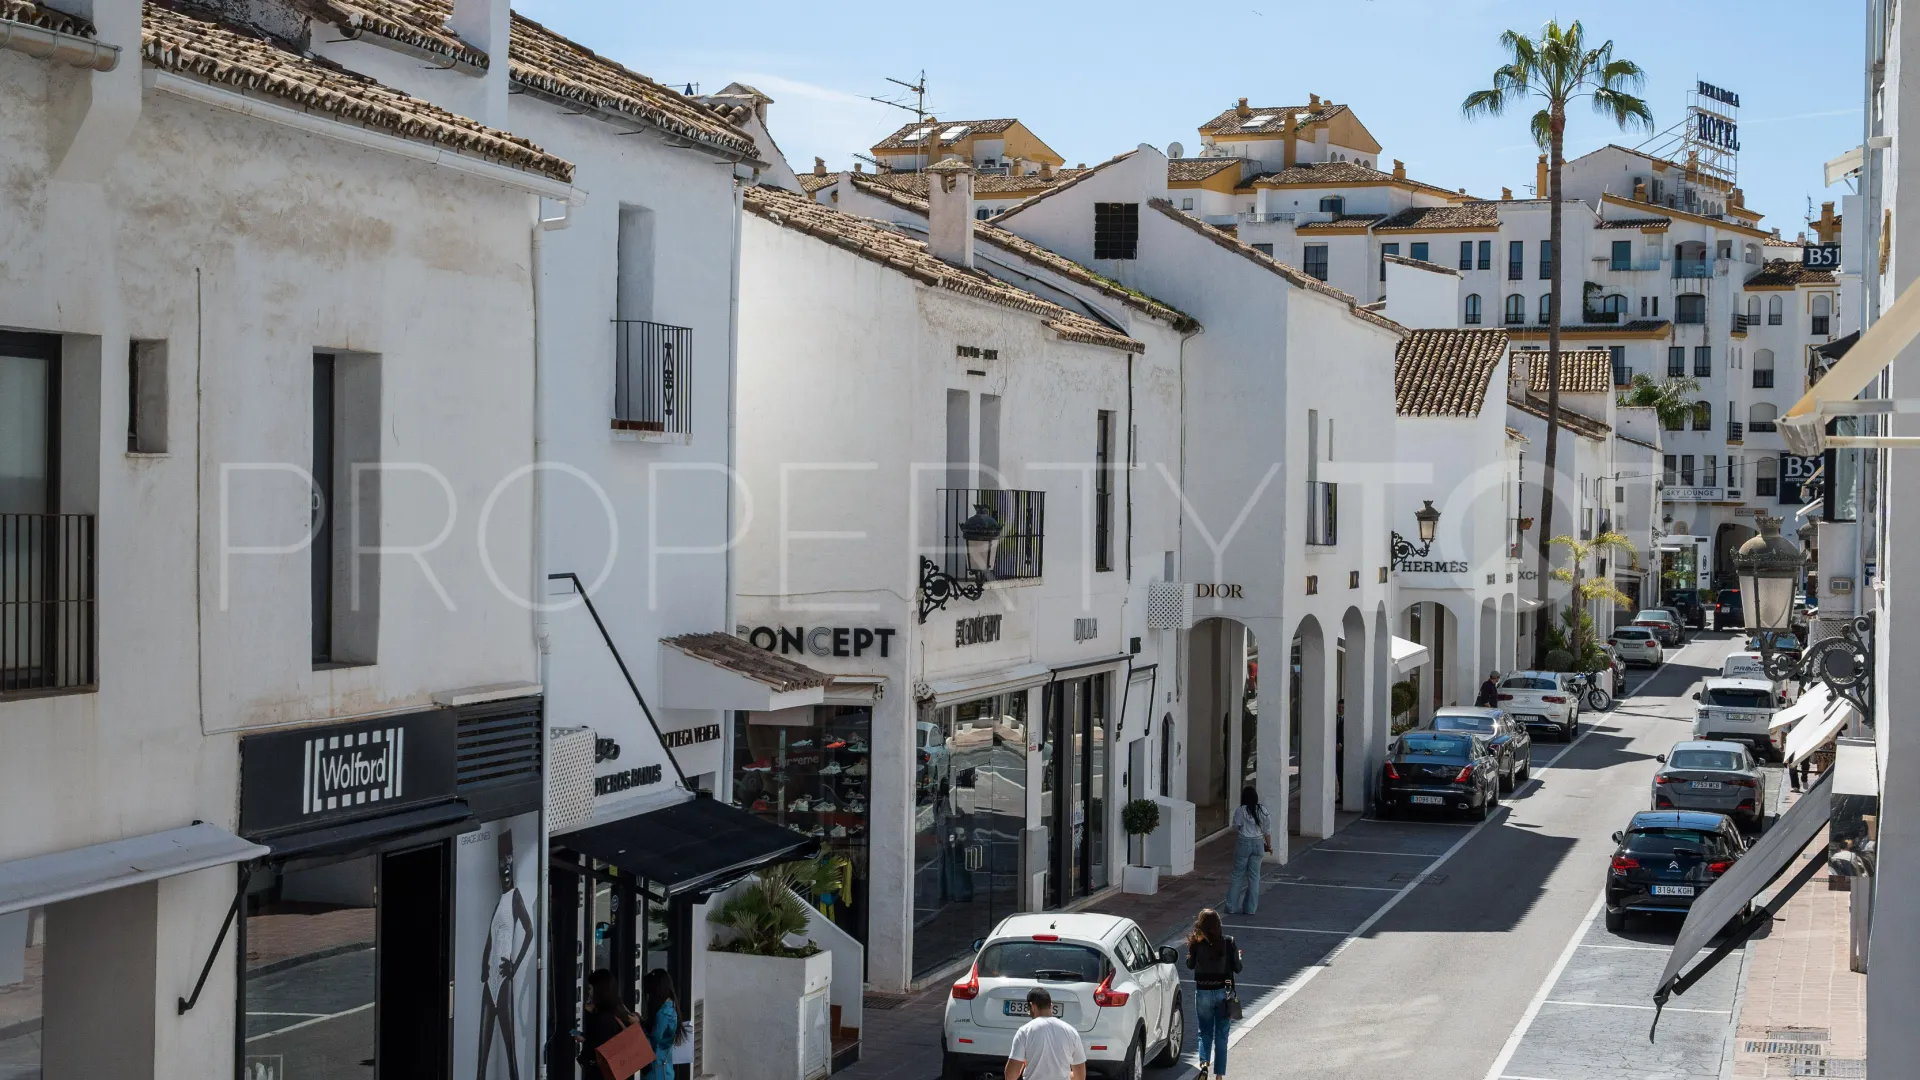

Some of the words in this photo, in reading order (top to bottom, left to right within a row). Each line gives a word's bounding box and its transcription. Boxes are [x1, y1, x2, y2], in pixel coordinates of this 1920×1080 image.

[1698, 112, 1740, 151] HOTEL
[1808, 248, 1841, 265] B51
[1196, 583, 1243, 598] DIOR
[694, 724, 721, 743] VENETA
[322, 748, 387, 791] Wolford
[461, 833, 477, 845] GRACE
[1657, 886, 1676, 894] 3194
[1010, 1003, 1029, 1013] 638
